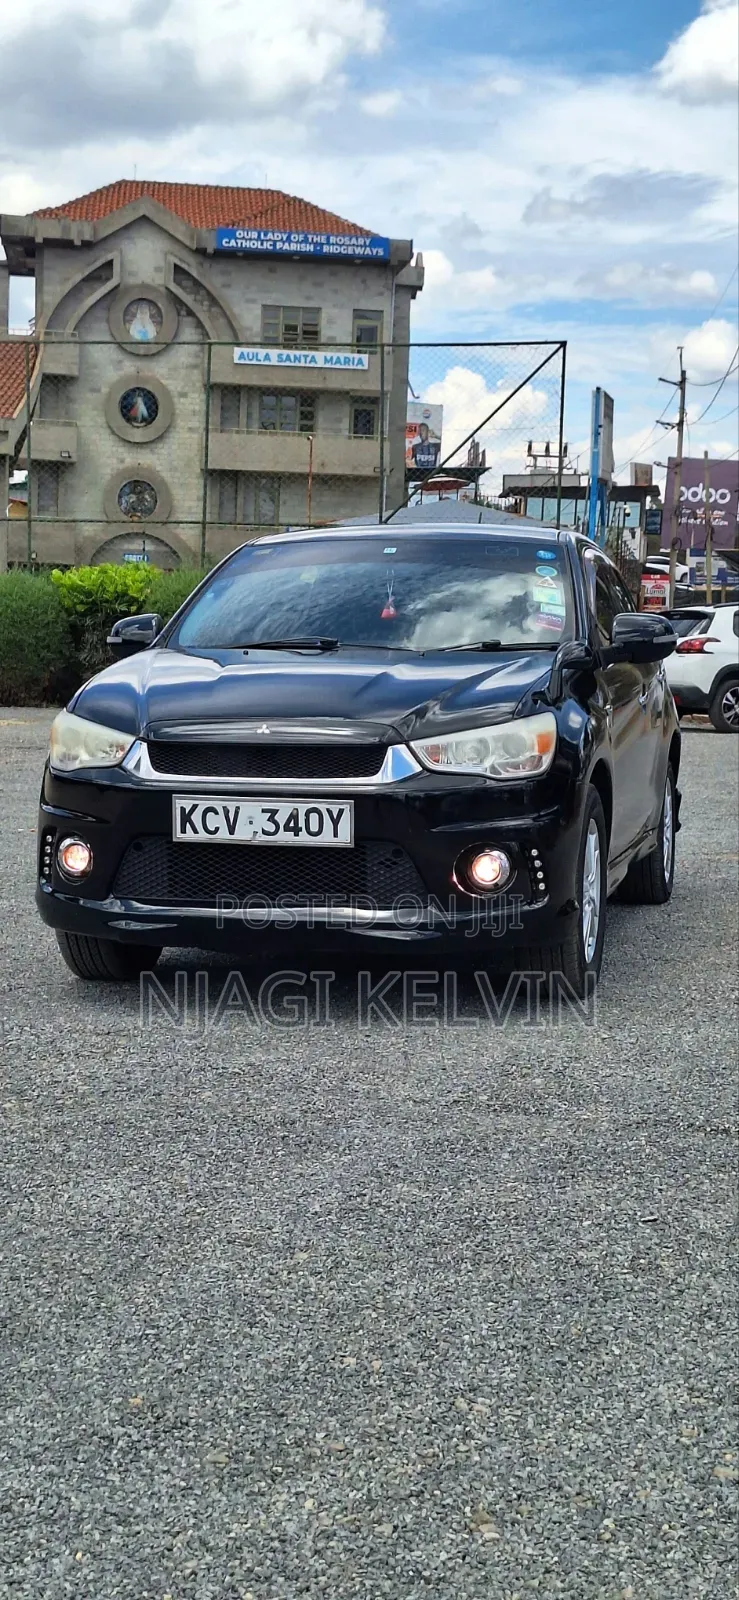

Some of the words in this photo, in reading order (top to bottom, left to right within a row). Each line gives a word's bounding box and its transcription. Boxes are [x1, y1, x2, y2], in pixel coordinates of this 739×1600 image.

[235, 230, 258, 239] OUR
[261, 232, 288, 241] LADY
[291, 234, 304, 242] OF
[308, 234, 327, 243] THE
[329, 236, 372, 246] ROSARY
[222, 238, 273, 250] CATHOLIC
[276, 242, 314, 252] PARISH
[322, 245, 384, 256] RIDGEWAYS
[237, 351, 272, 363] AULA
[276, 353, 318, 365] SANTA
[324, 355, 365, 367] MARIA
[416, 454, 435, 462] PEPSI
[179, 803, 241, 836] KCV
[260, 807, 345, 838] 340Y
